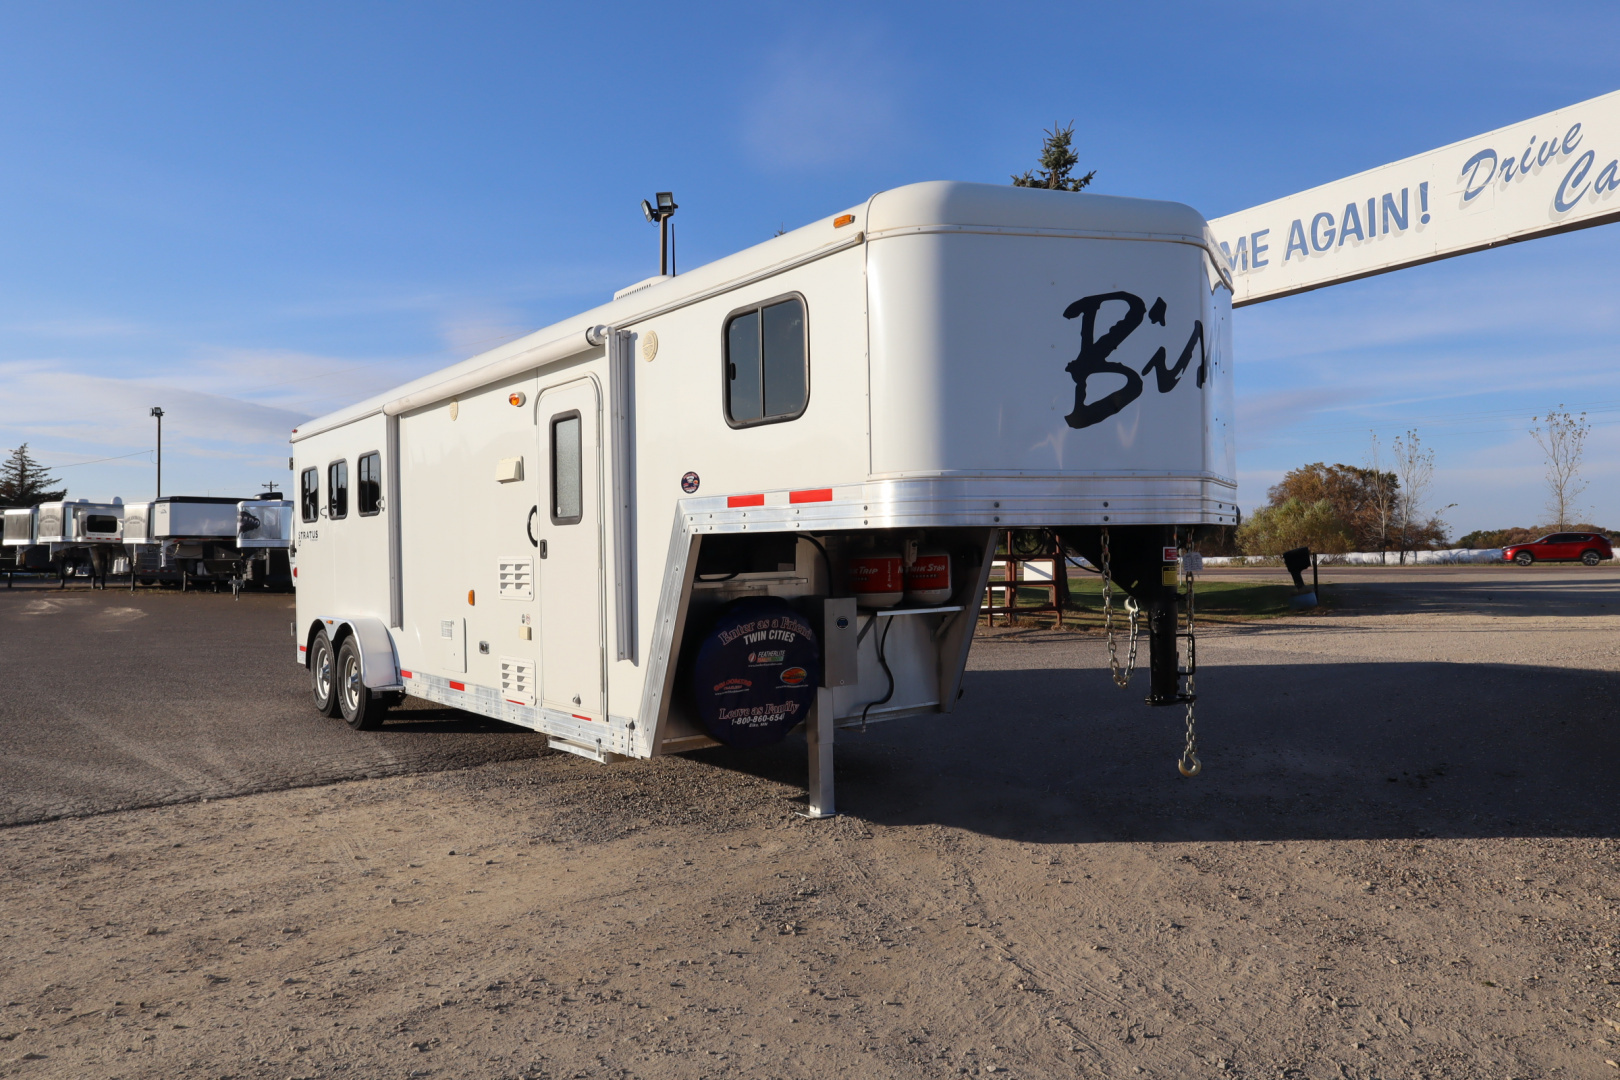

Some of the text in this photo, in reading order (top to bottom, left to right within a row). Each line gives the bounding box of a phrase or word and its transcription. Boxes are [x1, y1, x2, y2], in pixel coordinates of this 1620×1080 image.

[1461, 122, 1583, 202] Drive
[1284, 181, 1432, 261] AGAIN!
[298, 530, 318, 540] STRATUS
[718, 616, 812, 645] Enter as a Friend
[743, 629, 796, 645] TWIN CITIES
[758, 650, 785, 658] FEATHERLITE
[719, 700, 800, 720] Leave as Family
